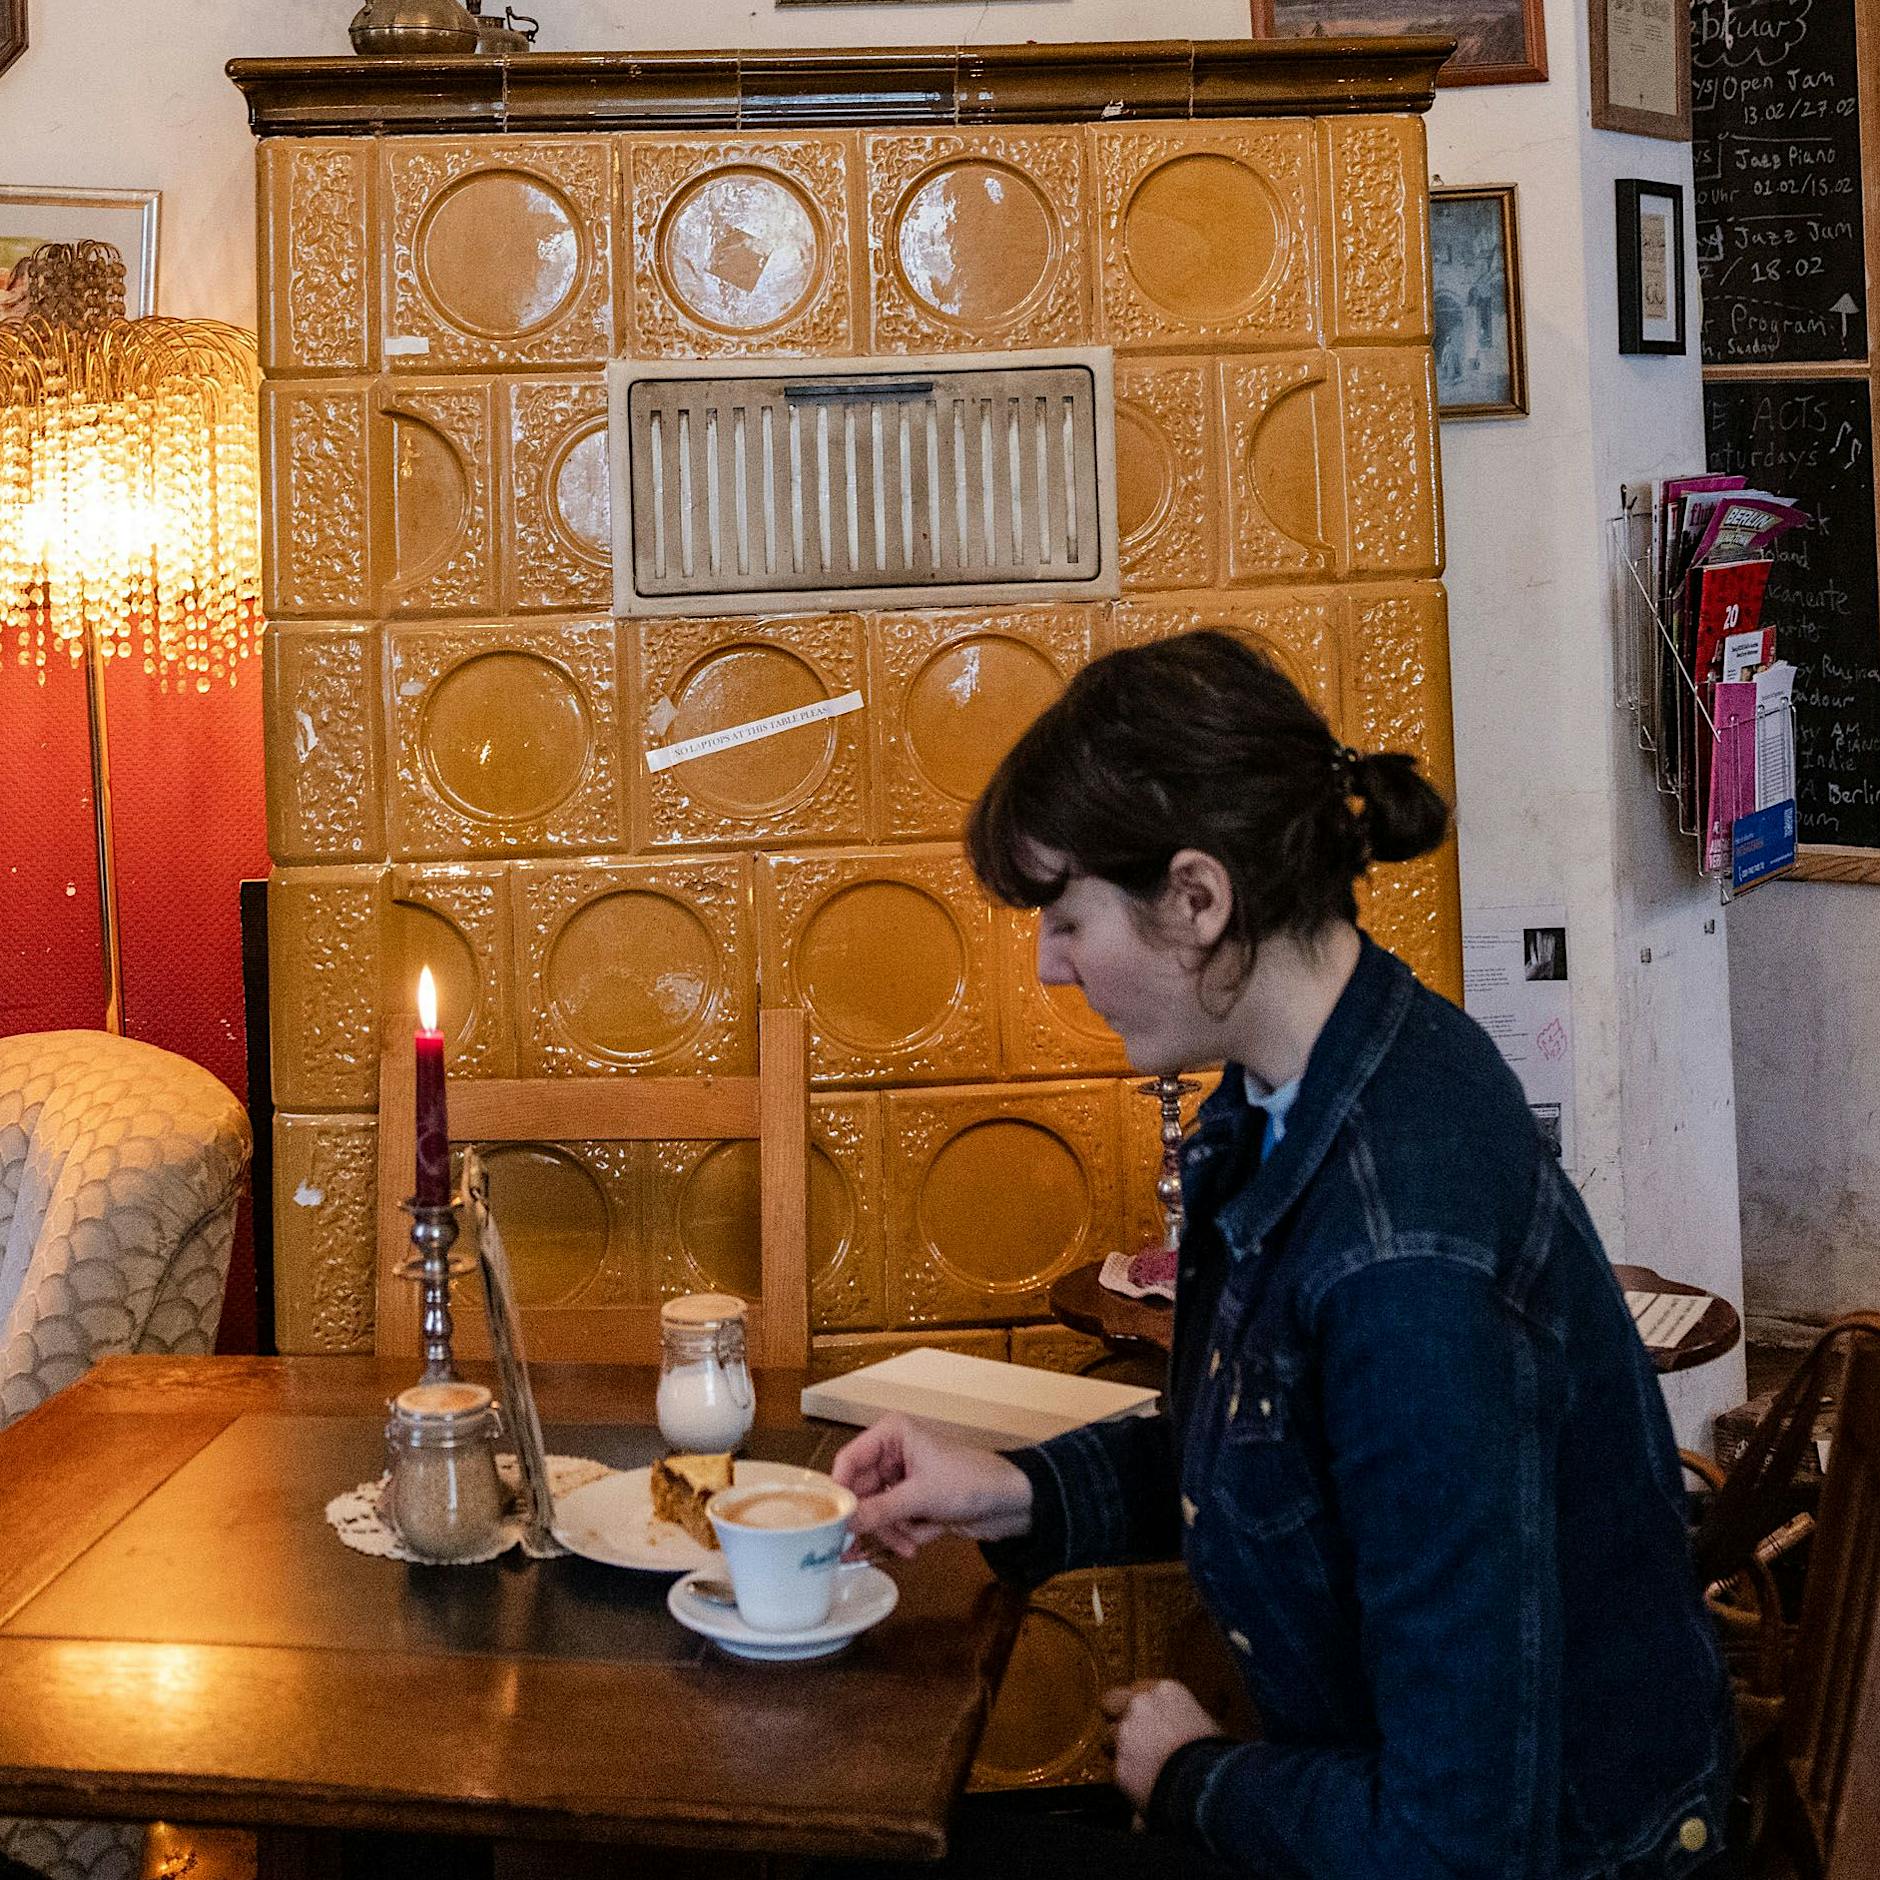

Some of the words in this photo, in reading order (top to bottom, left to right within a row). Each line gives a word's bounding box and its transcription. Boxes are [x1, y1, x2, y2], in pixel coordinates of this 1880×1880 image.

[1723, 75, 1773, 102] Open
[1787, 69, 1835, 91] Jam
[1789, 145, 1836, 167] Piano
[1734, 226, 1797, 249] Jazz
[1731, 303, 1828, 347] Program
[1752, 396, 1829, 432] ACTS
[1725, 507, 1773, 528] BERLIN
[1723, 604, 1740, 630] 20
[687, 735, 730, 753] LAPTOPS
[731, 730, 745, 742] AT
[746, 724, 768, 738] THIS
[768, 713, 799, 730] TABLE
[1801, 748, 1857, 772] Indie
